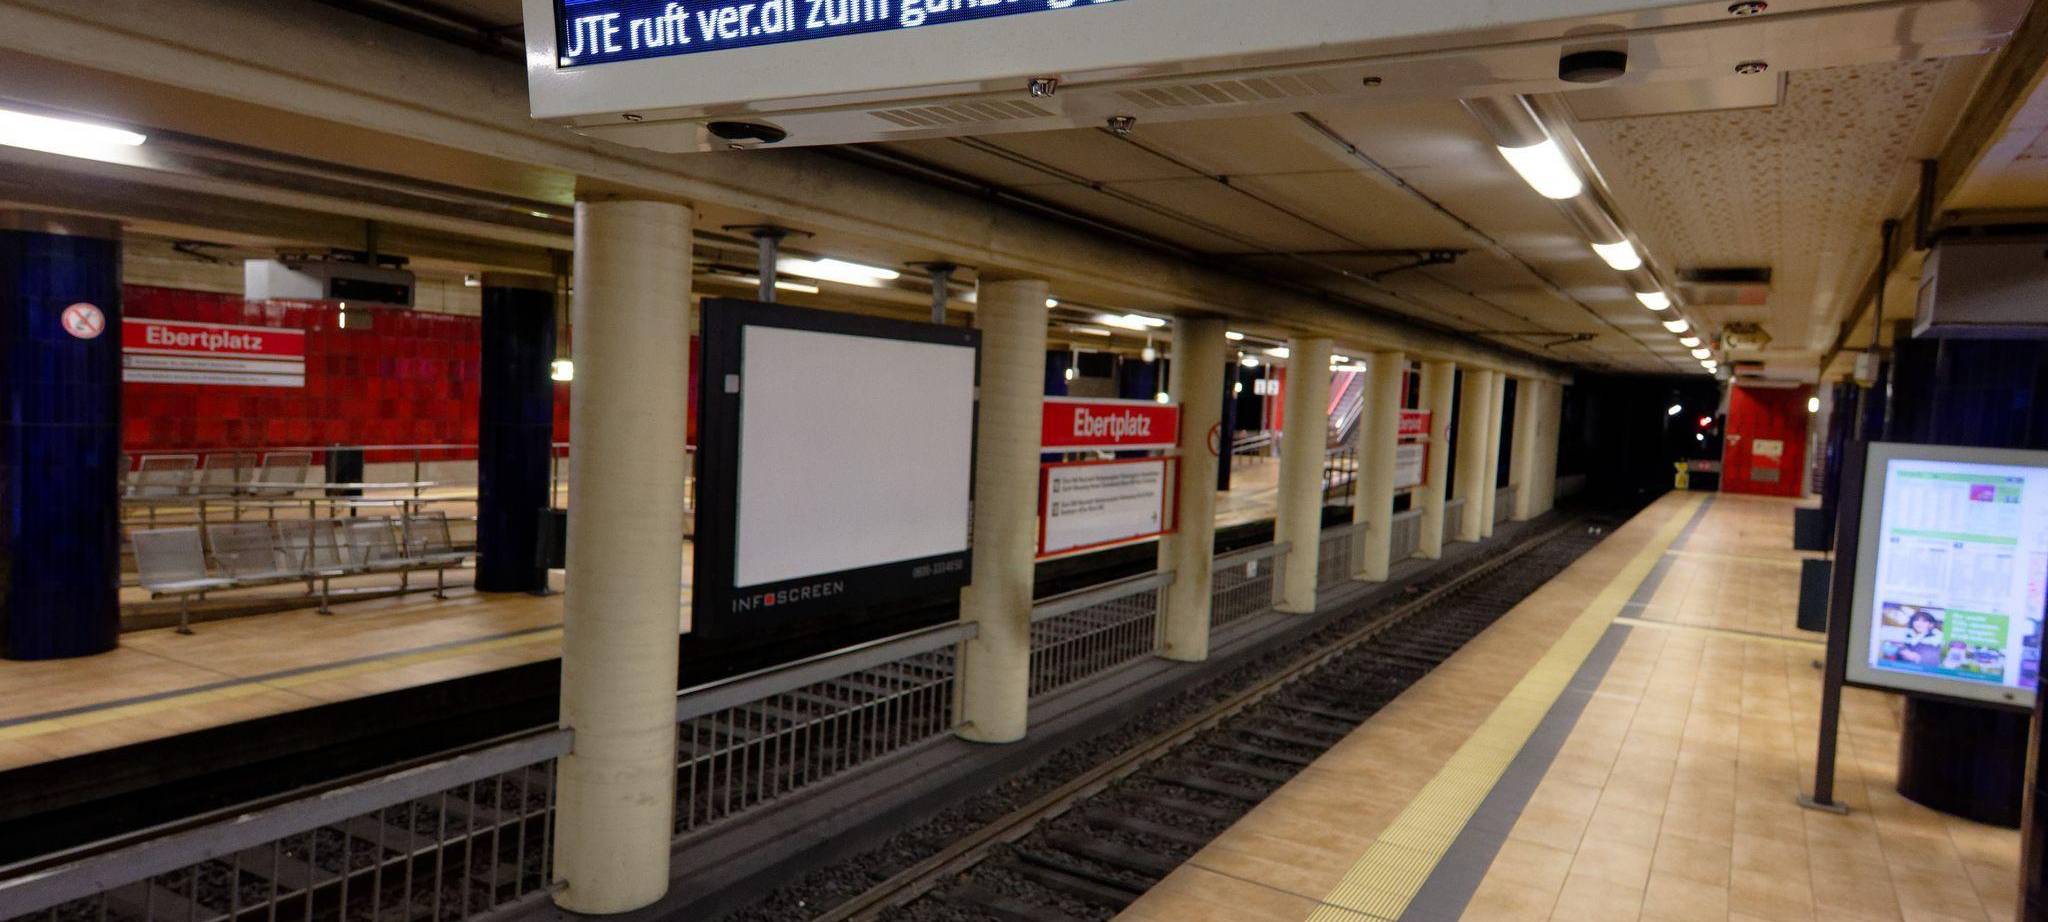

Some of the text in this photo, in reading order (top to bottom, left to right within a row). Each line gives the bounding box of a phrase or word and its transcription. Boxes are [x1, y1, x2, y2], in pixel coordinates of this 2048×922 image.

[630, 2, 691, 50] ruft
[696, 0, 796, 41] ver.di
[145, 325, 263, 351] Ebertplatz
[1073, 407, 1152, 442] Ebertplatz
[732, 580, 844, 614] INFOSCREEN
